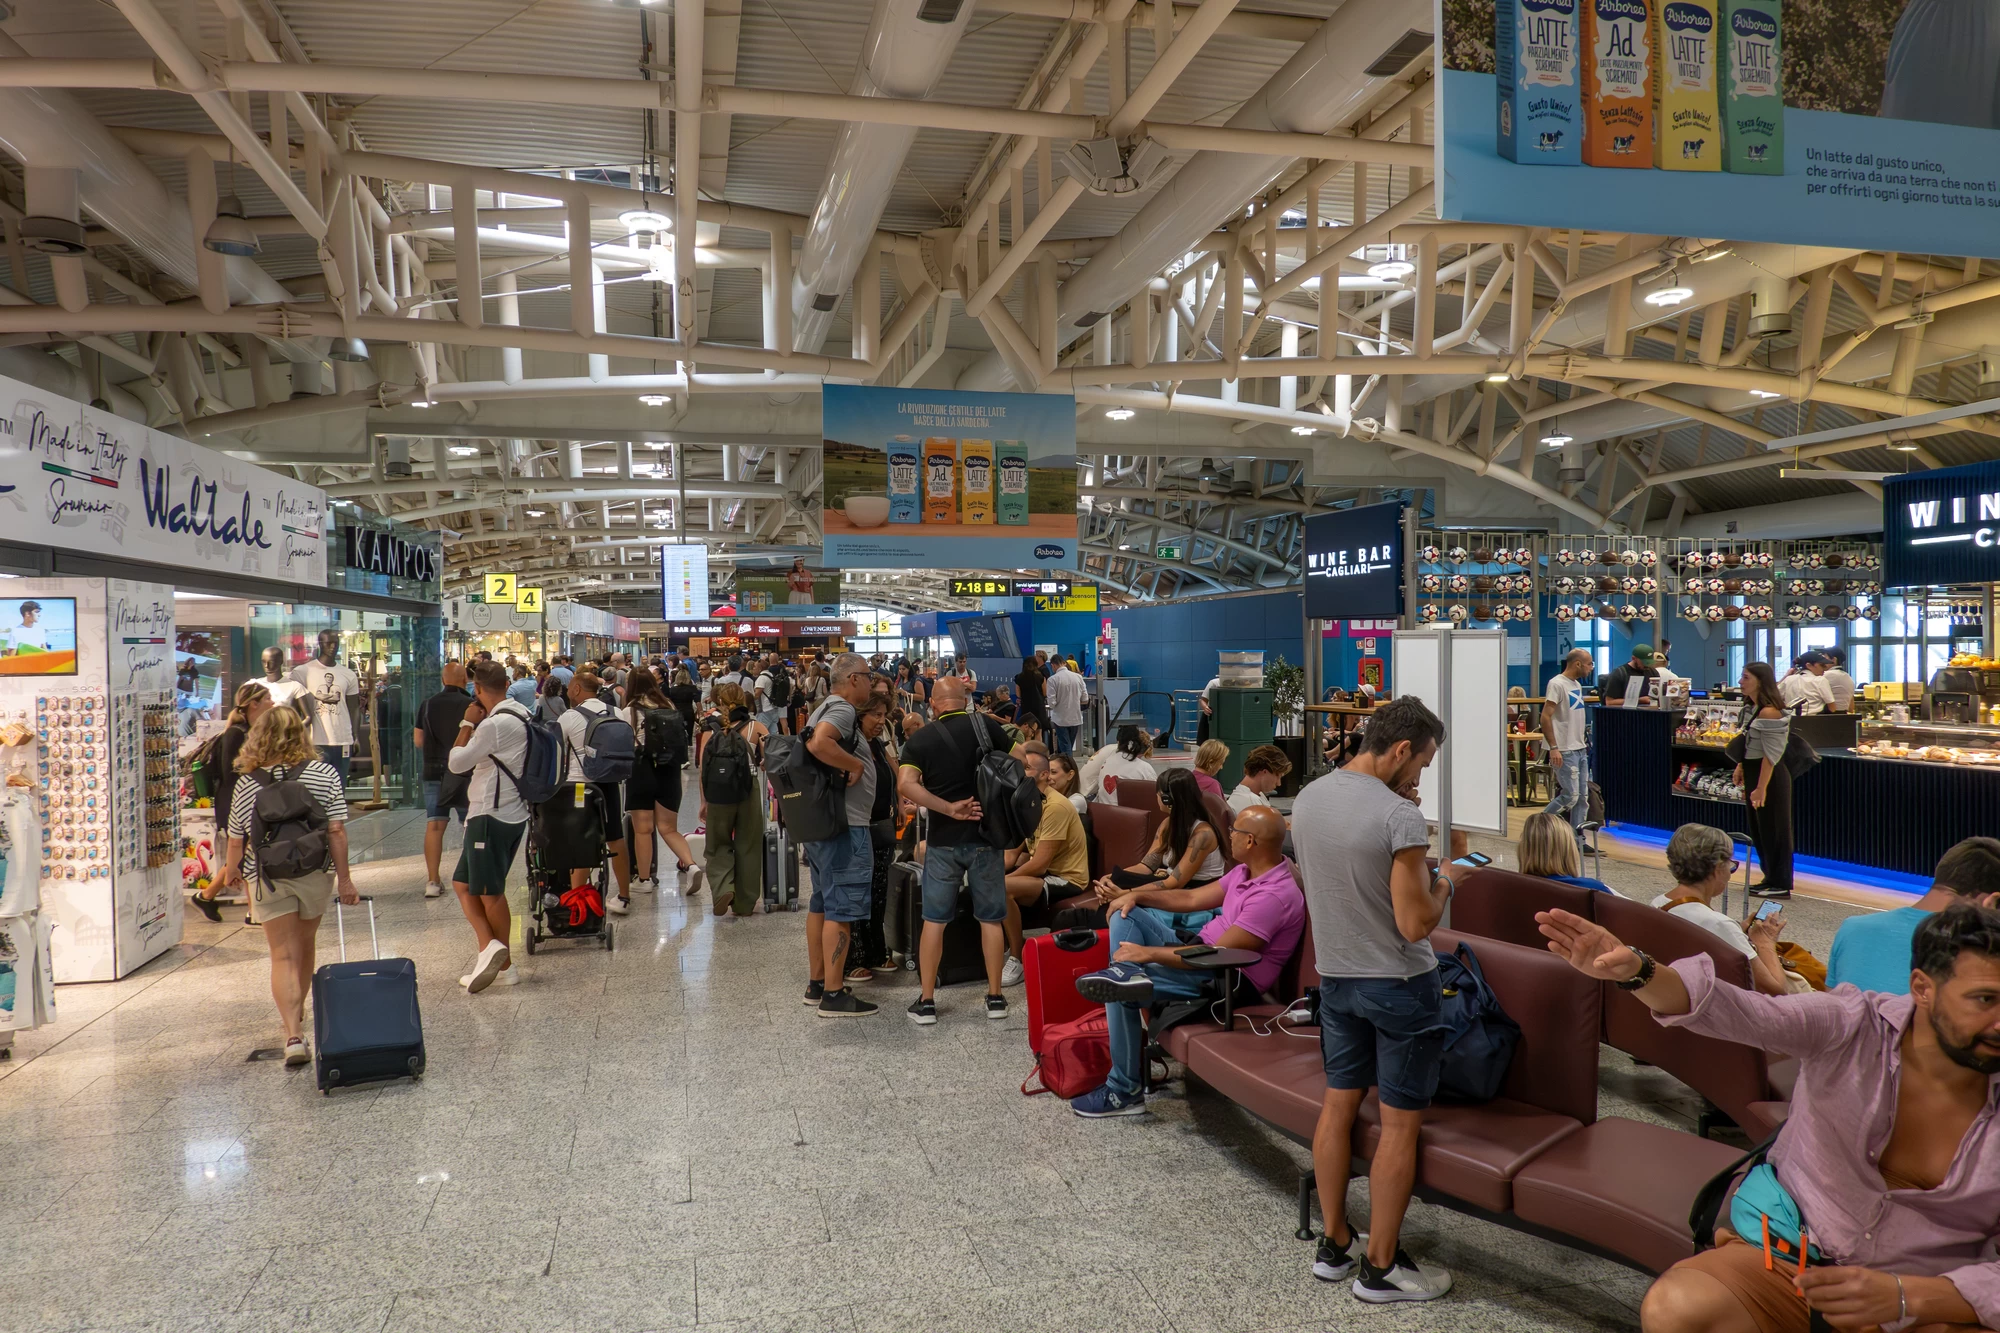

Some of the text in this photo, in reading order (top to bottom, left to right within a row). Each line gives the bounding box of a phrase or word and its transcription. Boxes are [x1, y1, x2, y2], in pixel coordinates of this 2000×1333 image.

[1598, 0, 1646, 16] Arborea
[1666, 8, 1711, 27] Arborea
[1735, 14, 1775, 33] Arborea
[1528, 16, 1569, 48] LATTE
[1605, 22, 1637, 57] Ad
[1527, 45, 1569, 62] PARZIALMENTE
[1671, 34, 1706, 64] LATTE
[1738, 40, 1771, 70] LATTE
[1535, 59, 1563, 73] SCREMATO
[1678, 62, 1701, 79] INTERO
[1605, 69, 1638, 85] SCREMATO
[1740, 68, 1771, 85] SCREMATO
[1528, 98, 1573, 116] Gusto Unico!
[1600, 107, 1620, 120] Senza
[1672, 108, 1712, 125] Gusto Unico!
[1806, 148, 1946, 175] Un latte dal gusto unico,
[1806, 164, 1996, 192] che arriva da una terra che non ti
[1807, 182, 1827, 195] per
[1829, 183, 1872, 198] offrirti
[1874, 188, 1900, 202] ogni
[1902, 189, 1939, 204] giorno
[1941, 193, 1973, 206] tutta
[1975, 195, 1986, 207] la
[898, 402, 1007, 418] LA RIVOLUZIONE GENTILE DEL LATTE
[913, 415, 934, 426] NASCE
[935, 416, 956, 427] DALLA
[28, 410, 128, 479] Made in Italy
[893, 467, 914, 480] LATTE
[932, 466, 948, 481] Ad
[967, 469, 987, 482] LATTE
[1003, 470, 1023, 482] LATTE
[50, 477, 112, 524] Souvenir
[139, 457, 272, 549] Waltale
[263, 498, 271, 510] TM
[1975, 528, 2000, 548] C
[286, 534, 316, 567] Souvenir
[354, 527, 436, 583] KAMPOS
[1036, 547, 1064, 555] Arborea
[1308, 545, 1391, 568] WINE BAR
[1325, 563, 1371, 577] CAGLIARI
[494, 578, 508, 596] 2
[955, 582, 982, 593] 7-18
[523, 591, 536, 607] 4
[115, 598, 140, 633] Made
[150, 602, 171, 636] Italy
[881, 622, 887, 630] 5
[127, 647, 163, 685] Souvenir
